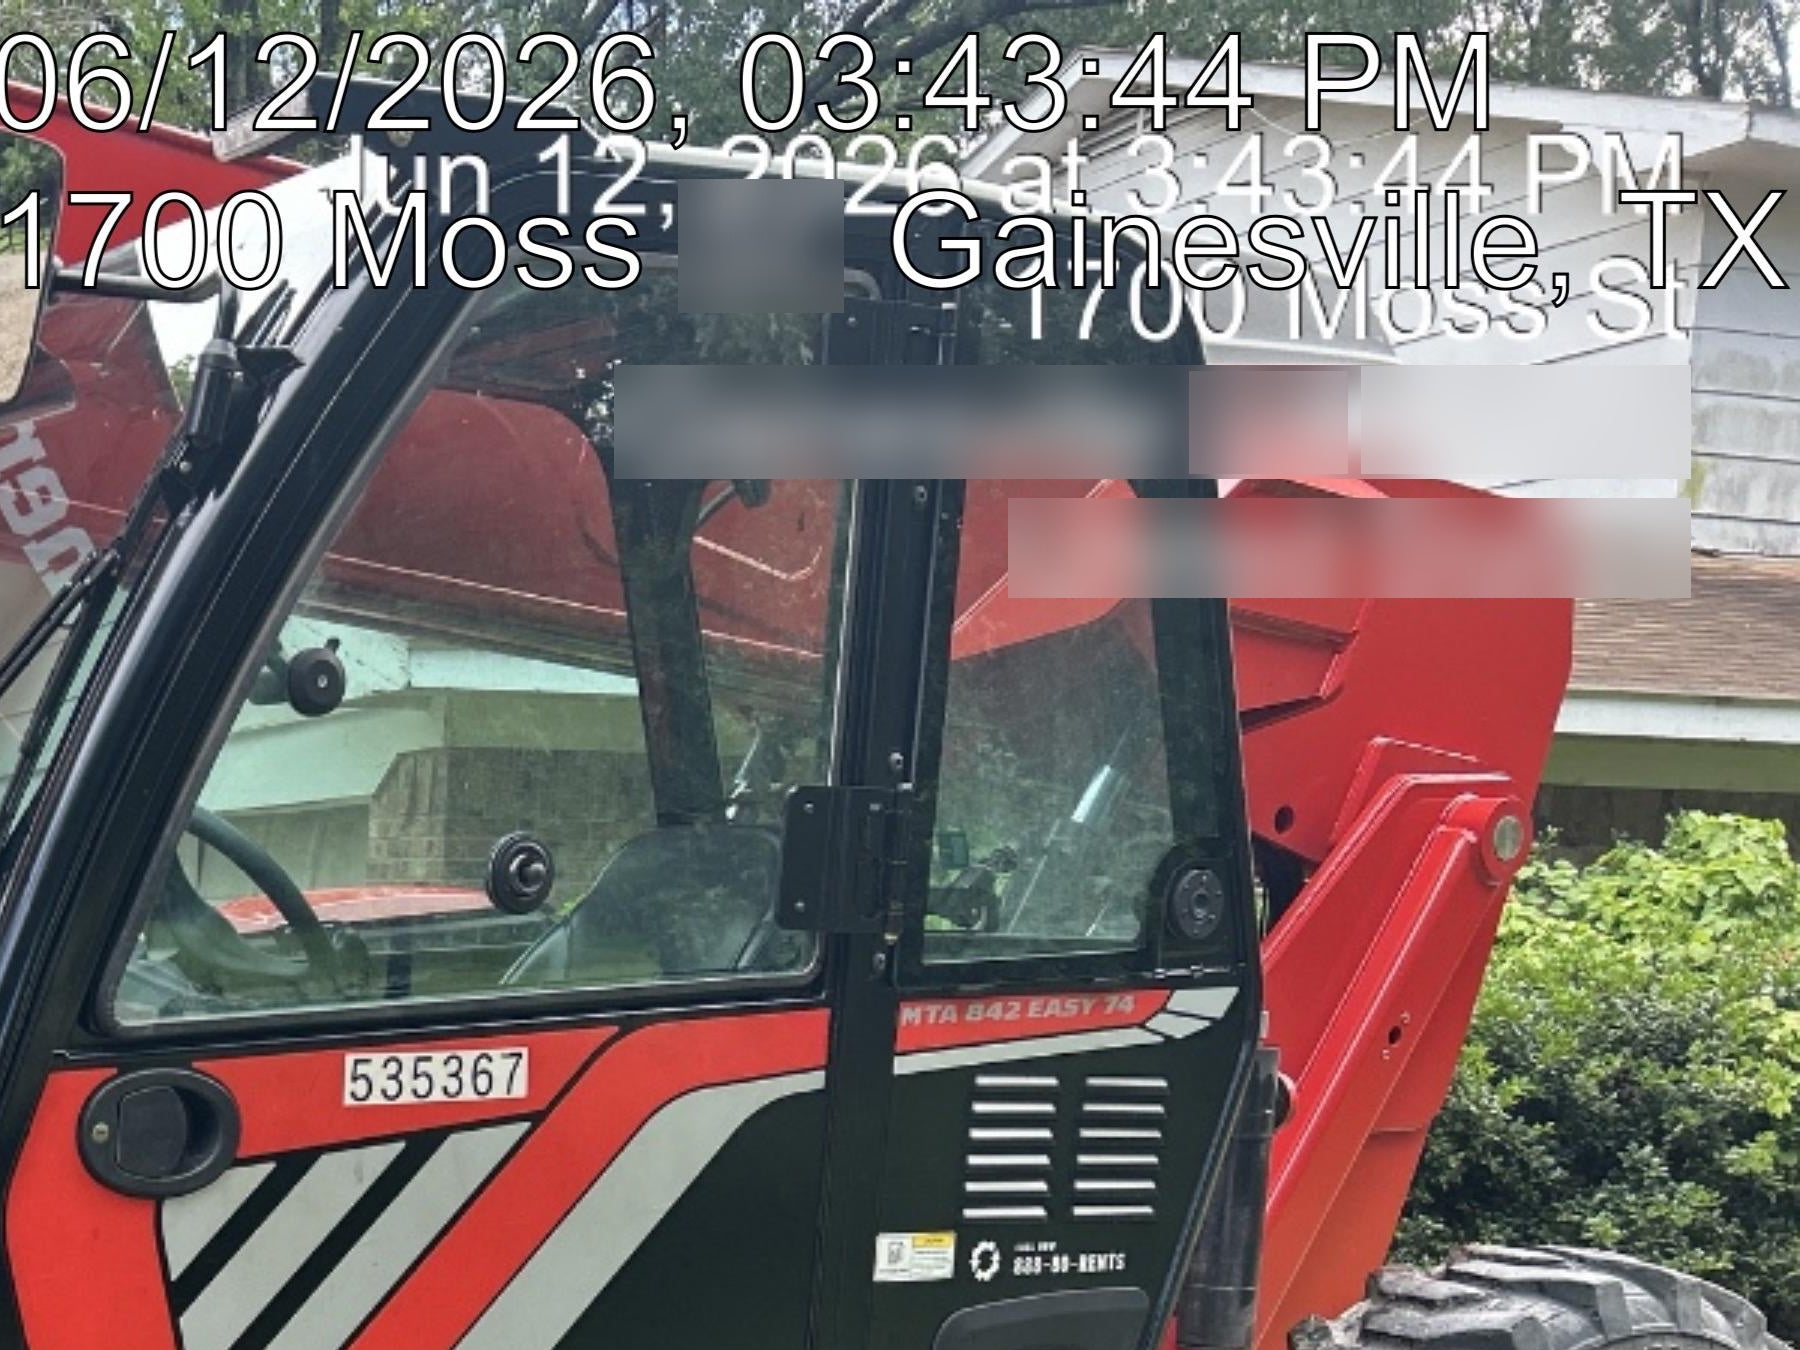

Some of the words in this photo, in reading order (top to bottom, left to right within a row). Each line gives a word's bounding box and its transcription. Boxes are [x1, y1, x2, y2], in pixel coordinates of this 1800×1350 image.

[901, 1005, 958, 1027] MTA
[965, 1000, 1021, 1021] 842
[1028, 997, 1096, 1019] EASY
[349, 1051, 524, 1102] 535367
